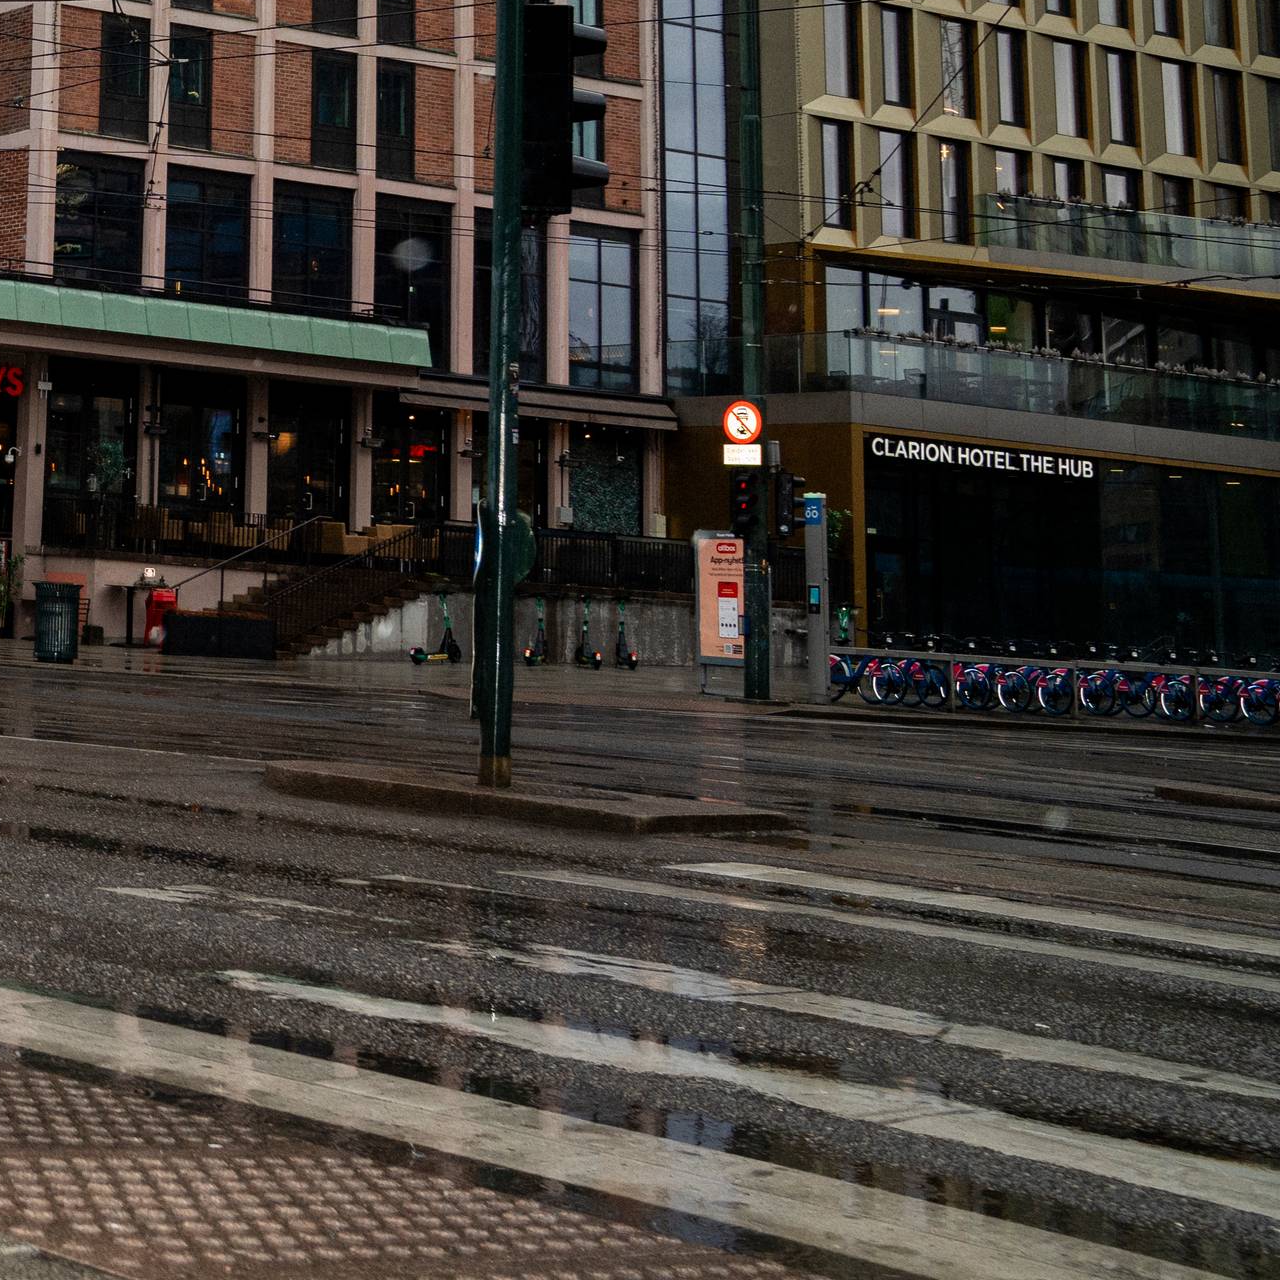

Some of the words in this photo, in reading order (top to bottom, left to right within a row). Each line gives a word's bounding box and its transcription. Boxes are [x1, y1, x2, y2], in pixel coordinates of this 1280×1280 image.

[871, 437, 953, 463] CLARION
[958, 447, 1017, 470] HOTEL
[1021, 453, 1054, 474] THE
[1058, 458, 1094, 478] HUB
